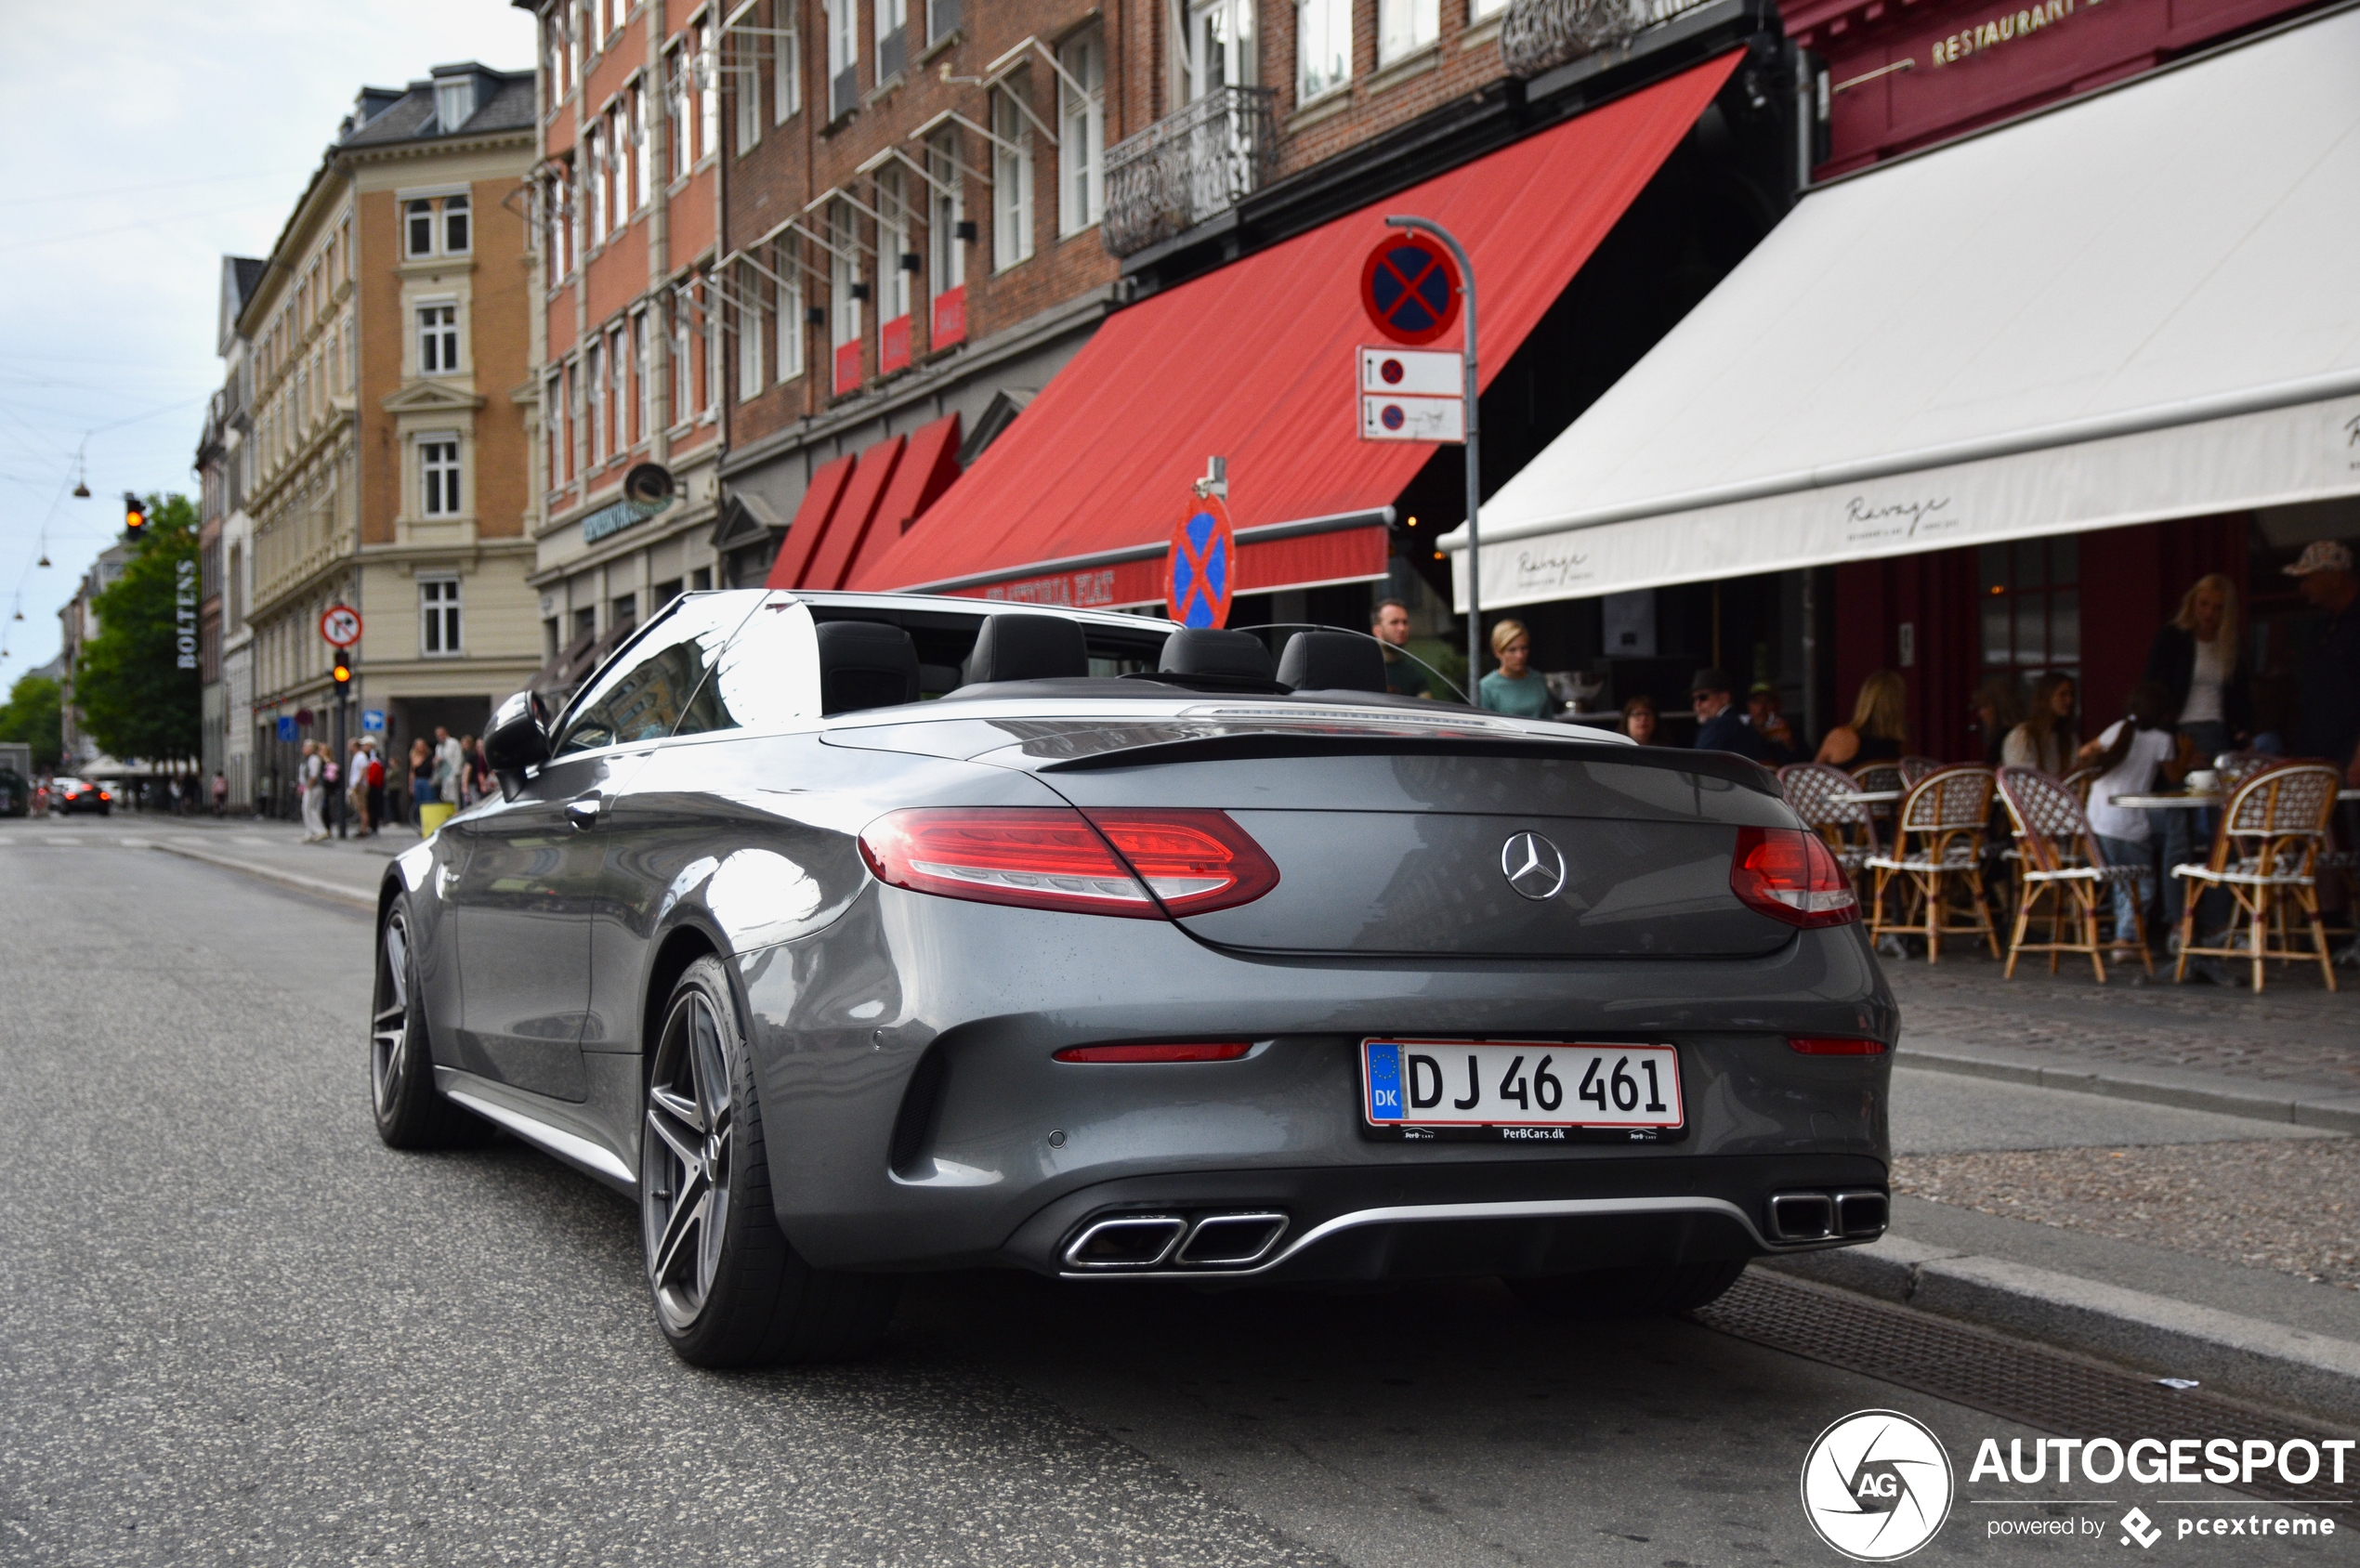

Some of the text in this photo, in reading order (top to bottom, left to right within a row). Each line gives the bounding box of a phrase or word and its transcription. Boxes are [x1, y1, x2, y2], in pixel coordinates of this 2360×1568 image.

[1845, 495, 1951, 538] Ravage
[1075, 570, 1114, 605] FIAT
[176, 559, 197, 669] BOLTENS
[1375, 1090, 1397, 1106] DK
[1500, 1053, 1563, 1112] 46
[1579, 1055, 1667, 1113] 461
[731, 1083, 742, 1163] EAGL
[1502, 1128, 1566, 1140] PerBCars.dk
